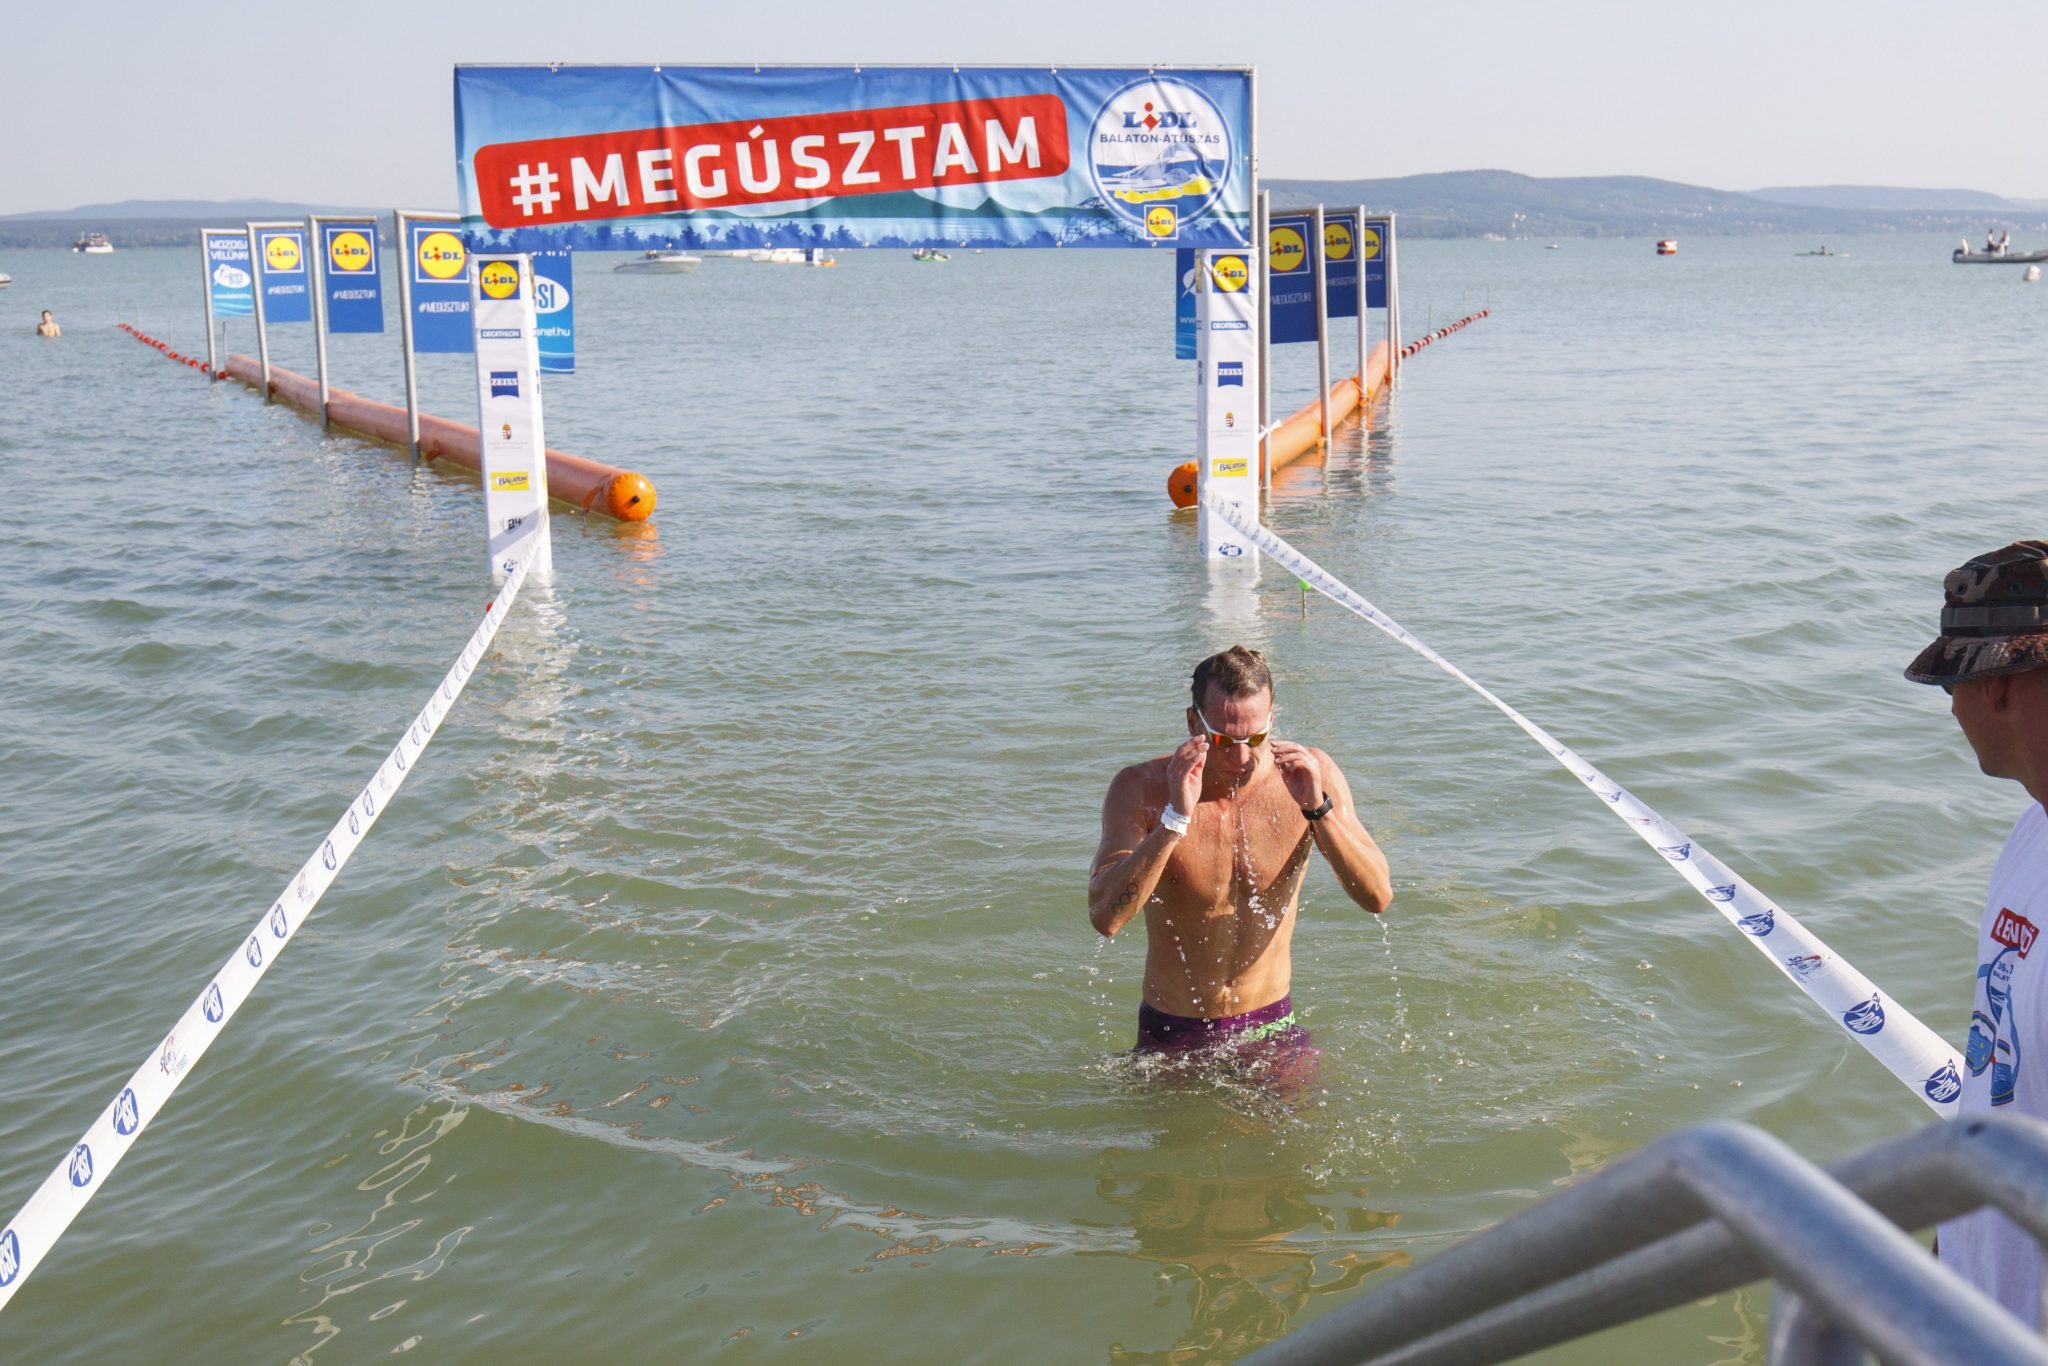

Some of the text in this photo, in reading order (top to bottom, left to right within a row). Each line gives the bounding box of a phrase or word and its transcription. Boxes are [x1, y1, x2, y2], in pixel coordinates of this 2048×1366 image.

[1100, 132, 1220, 144] BALATON-ÁTÚSZÁS
[510, 116, 1041, 217] #MEGÚSZTAM
[533, 284, 555, 309] SI
[1218, 368, 1243, 376] ZEISS
[491, 378, 519, 386] ZEISS
[499, 475, 528, 485] BALATON
[1847, 1011, 1883, 1031] BSI
[1928, 1078, 1960, 1102] BSI
